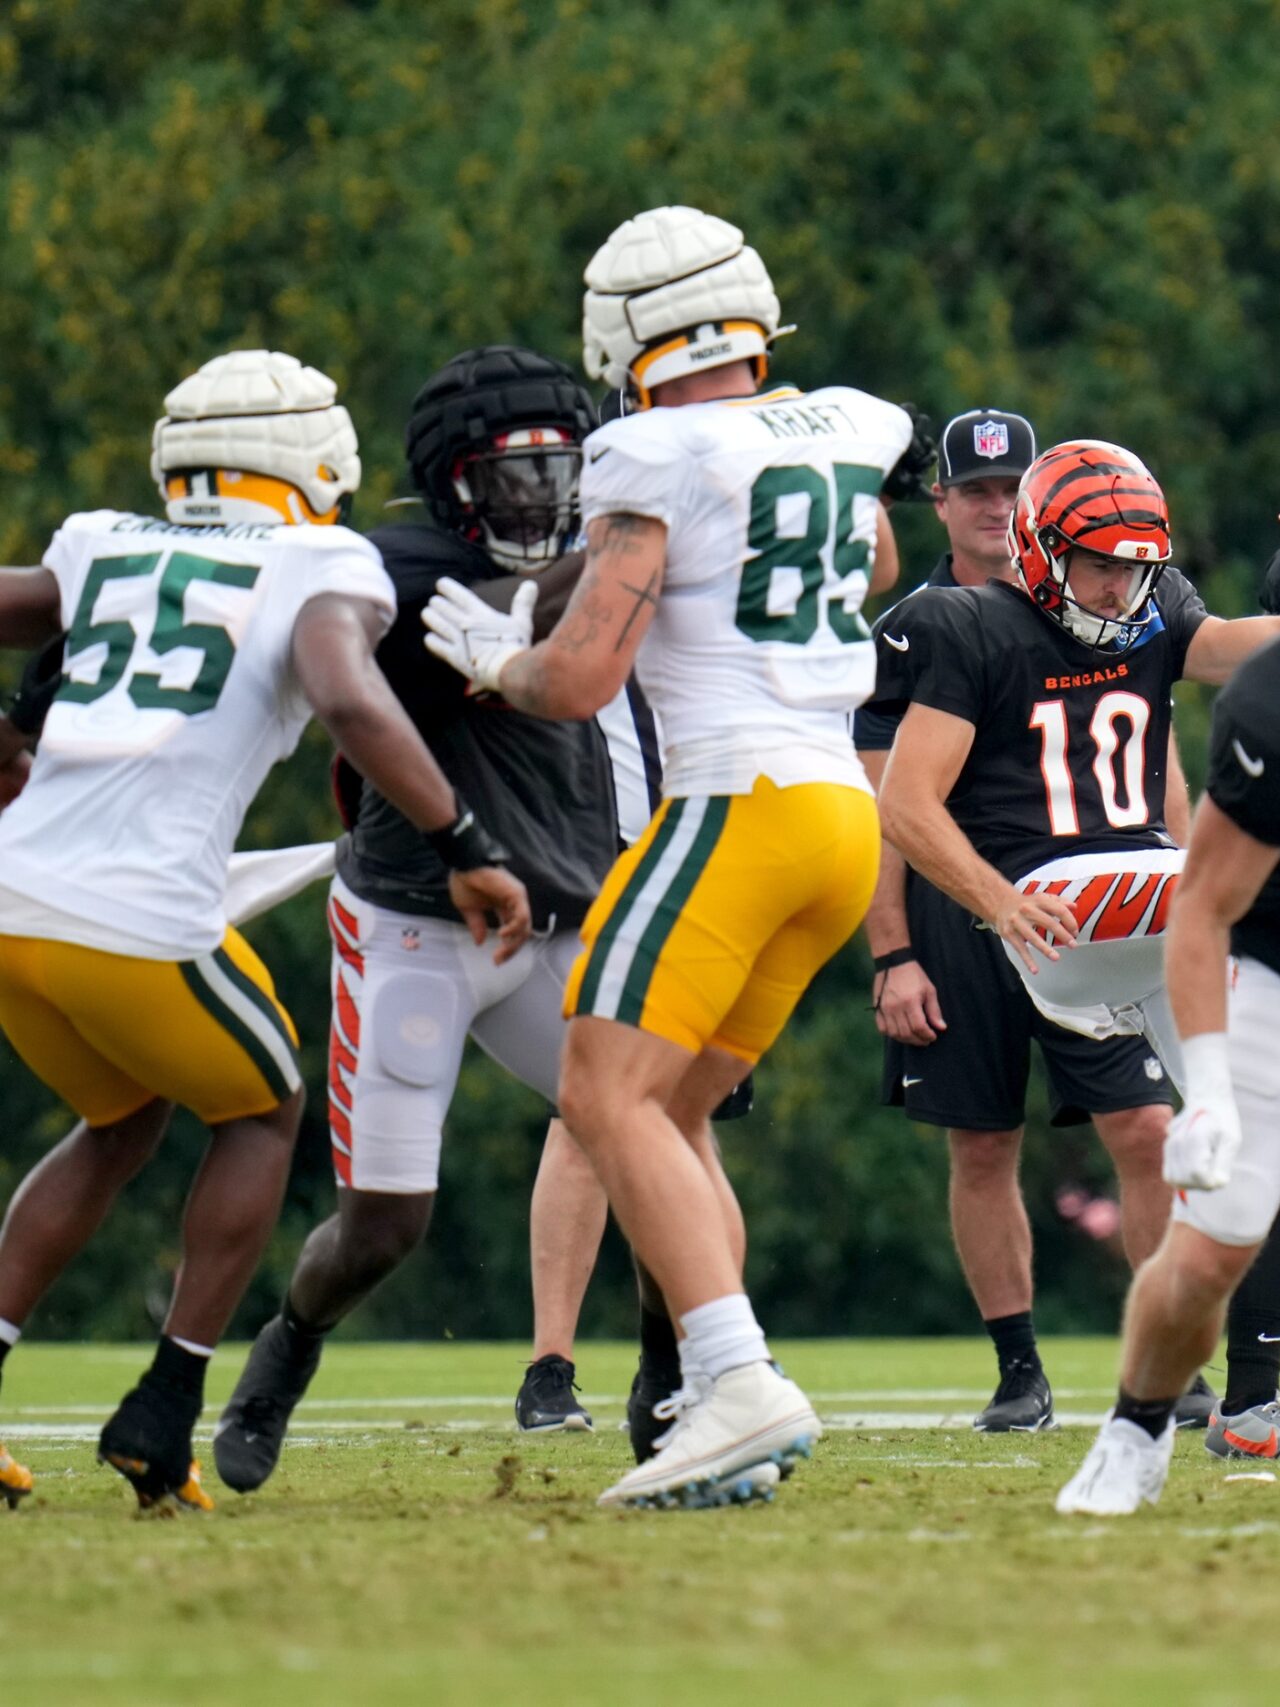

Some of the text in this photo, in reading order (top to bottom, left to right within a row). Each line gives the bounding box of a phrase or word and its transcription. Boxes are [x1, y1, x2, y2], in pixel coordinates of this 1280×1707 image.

[749, 404, 858, 438] KRAFT
[979, 436, 1006, 452] NFL
[735, 461, 884, 646] 85
[53, 549, 262, 716] 55
[1044, 664, 1129, 690] BENGALS
[1028, 690, 1150, 836] 10
